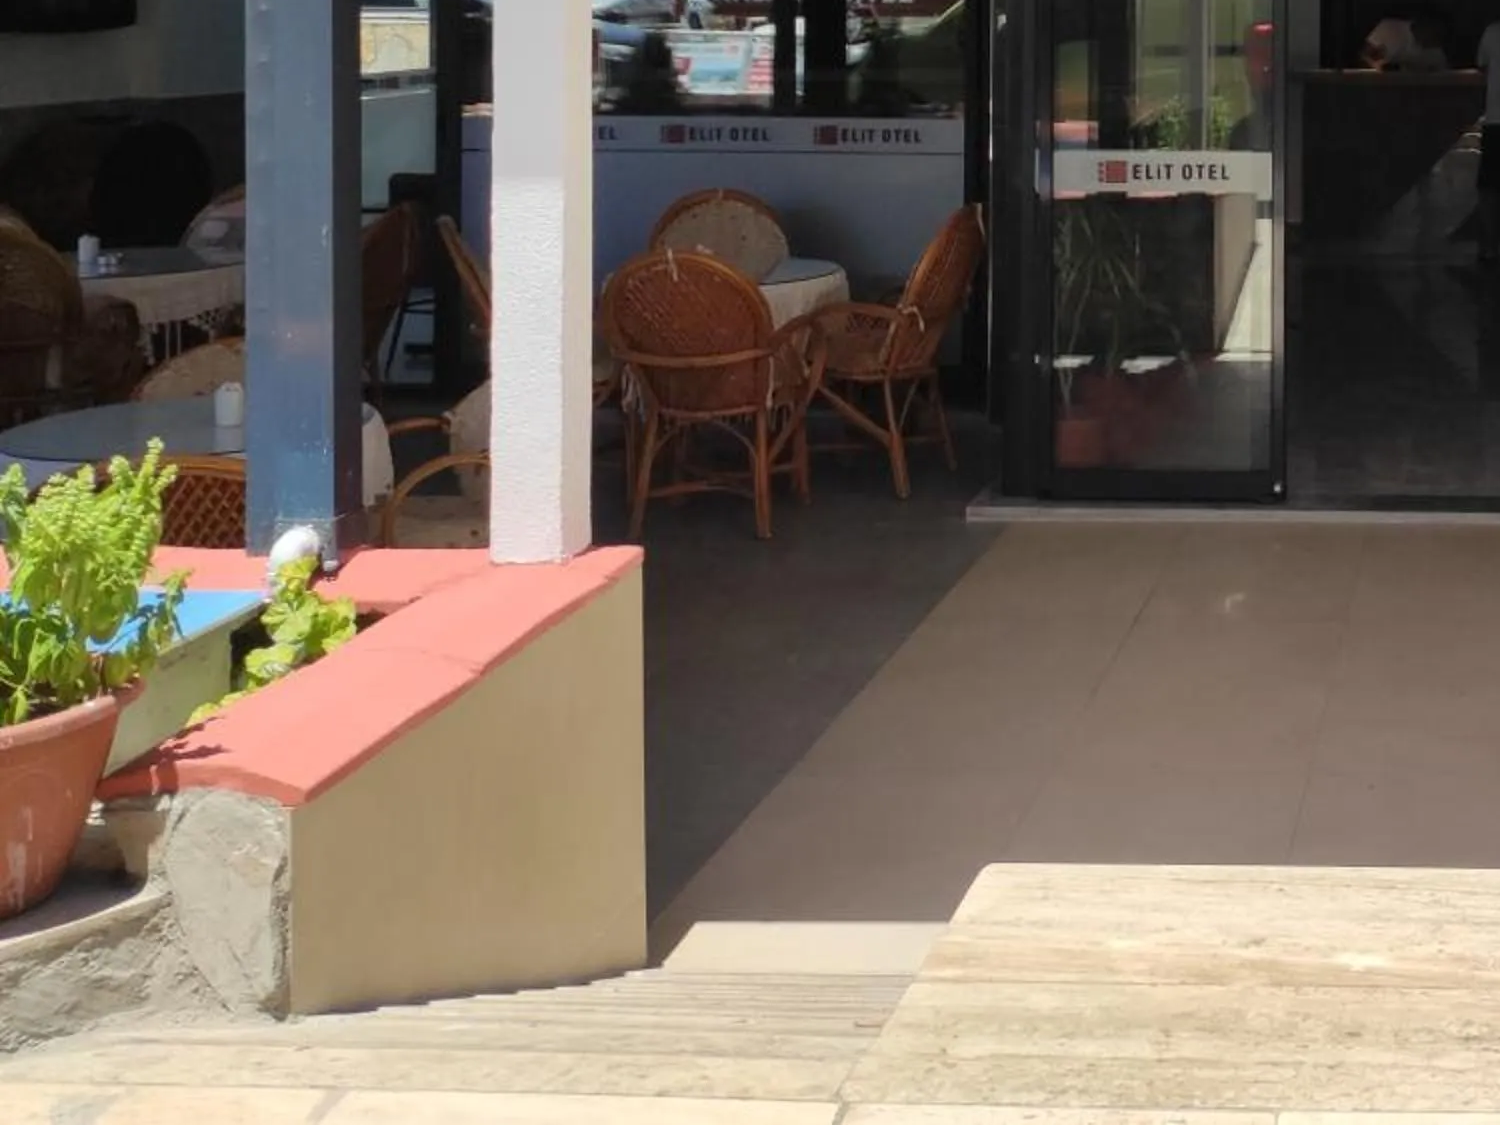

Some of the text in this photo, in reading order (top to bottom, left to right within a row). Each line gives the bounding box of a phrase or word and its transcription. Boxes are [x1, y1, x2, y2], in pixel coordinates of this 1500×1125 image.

[729, 126, 770, 142] OTEL
[881, 127, 922, 144] OTEL
[1181, 163, 1231, 181] OTEL
